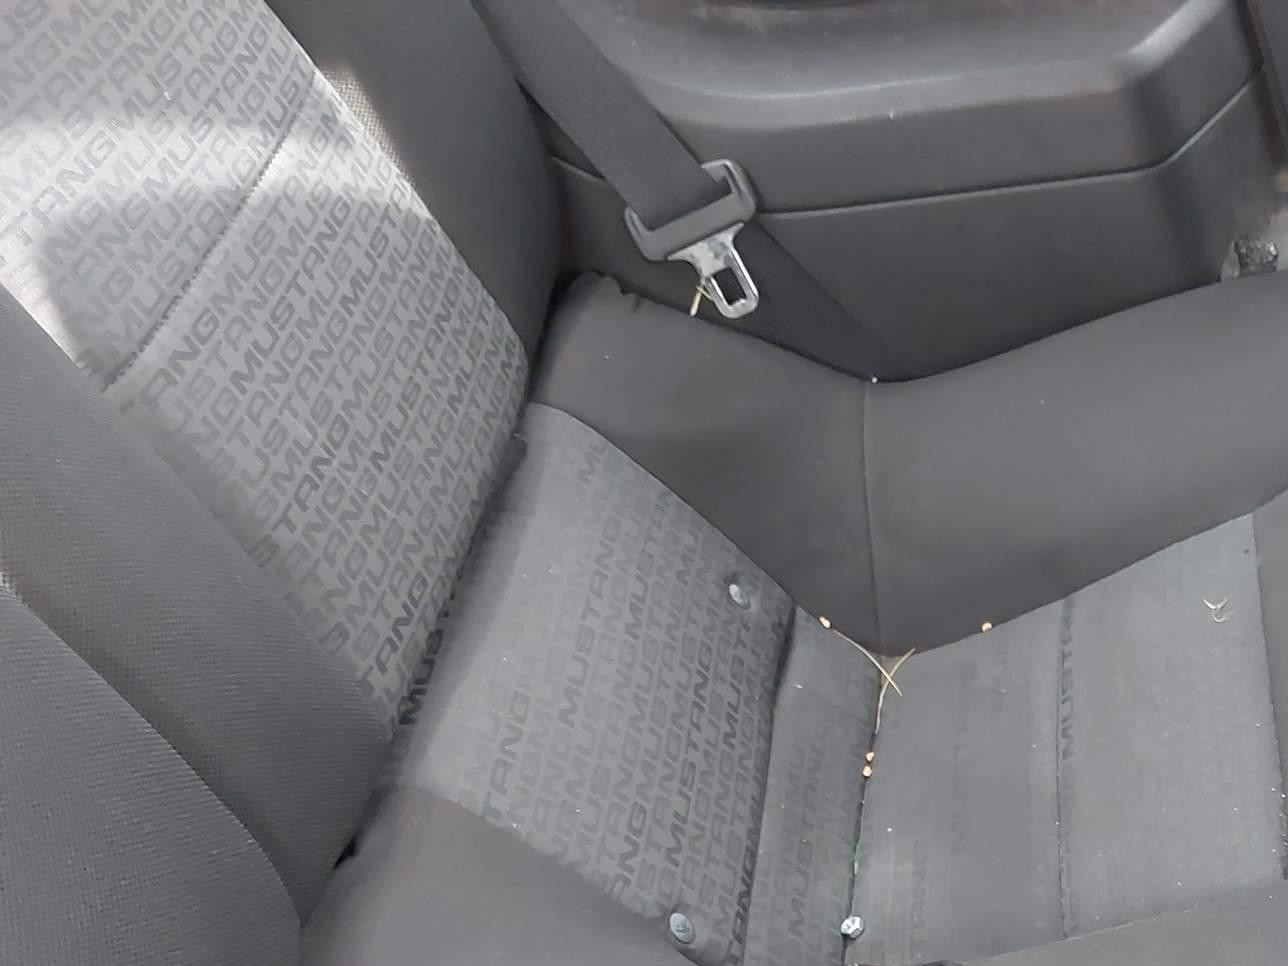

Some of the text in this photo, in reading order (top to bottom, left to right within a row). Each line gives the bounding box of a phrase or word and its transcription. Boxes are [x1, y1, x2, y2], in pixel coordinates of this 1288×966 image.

[227, 192, 354, 395] MUSTANG
[364, 275, 464, 472] MUSTANG
[553, 513, 621, 729] MUSTANG
[658, 638, 716, 867] MUSTANG
